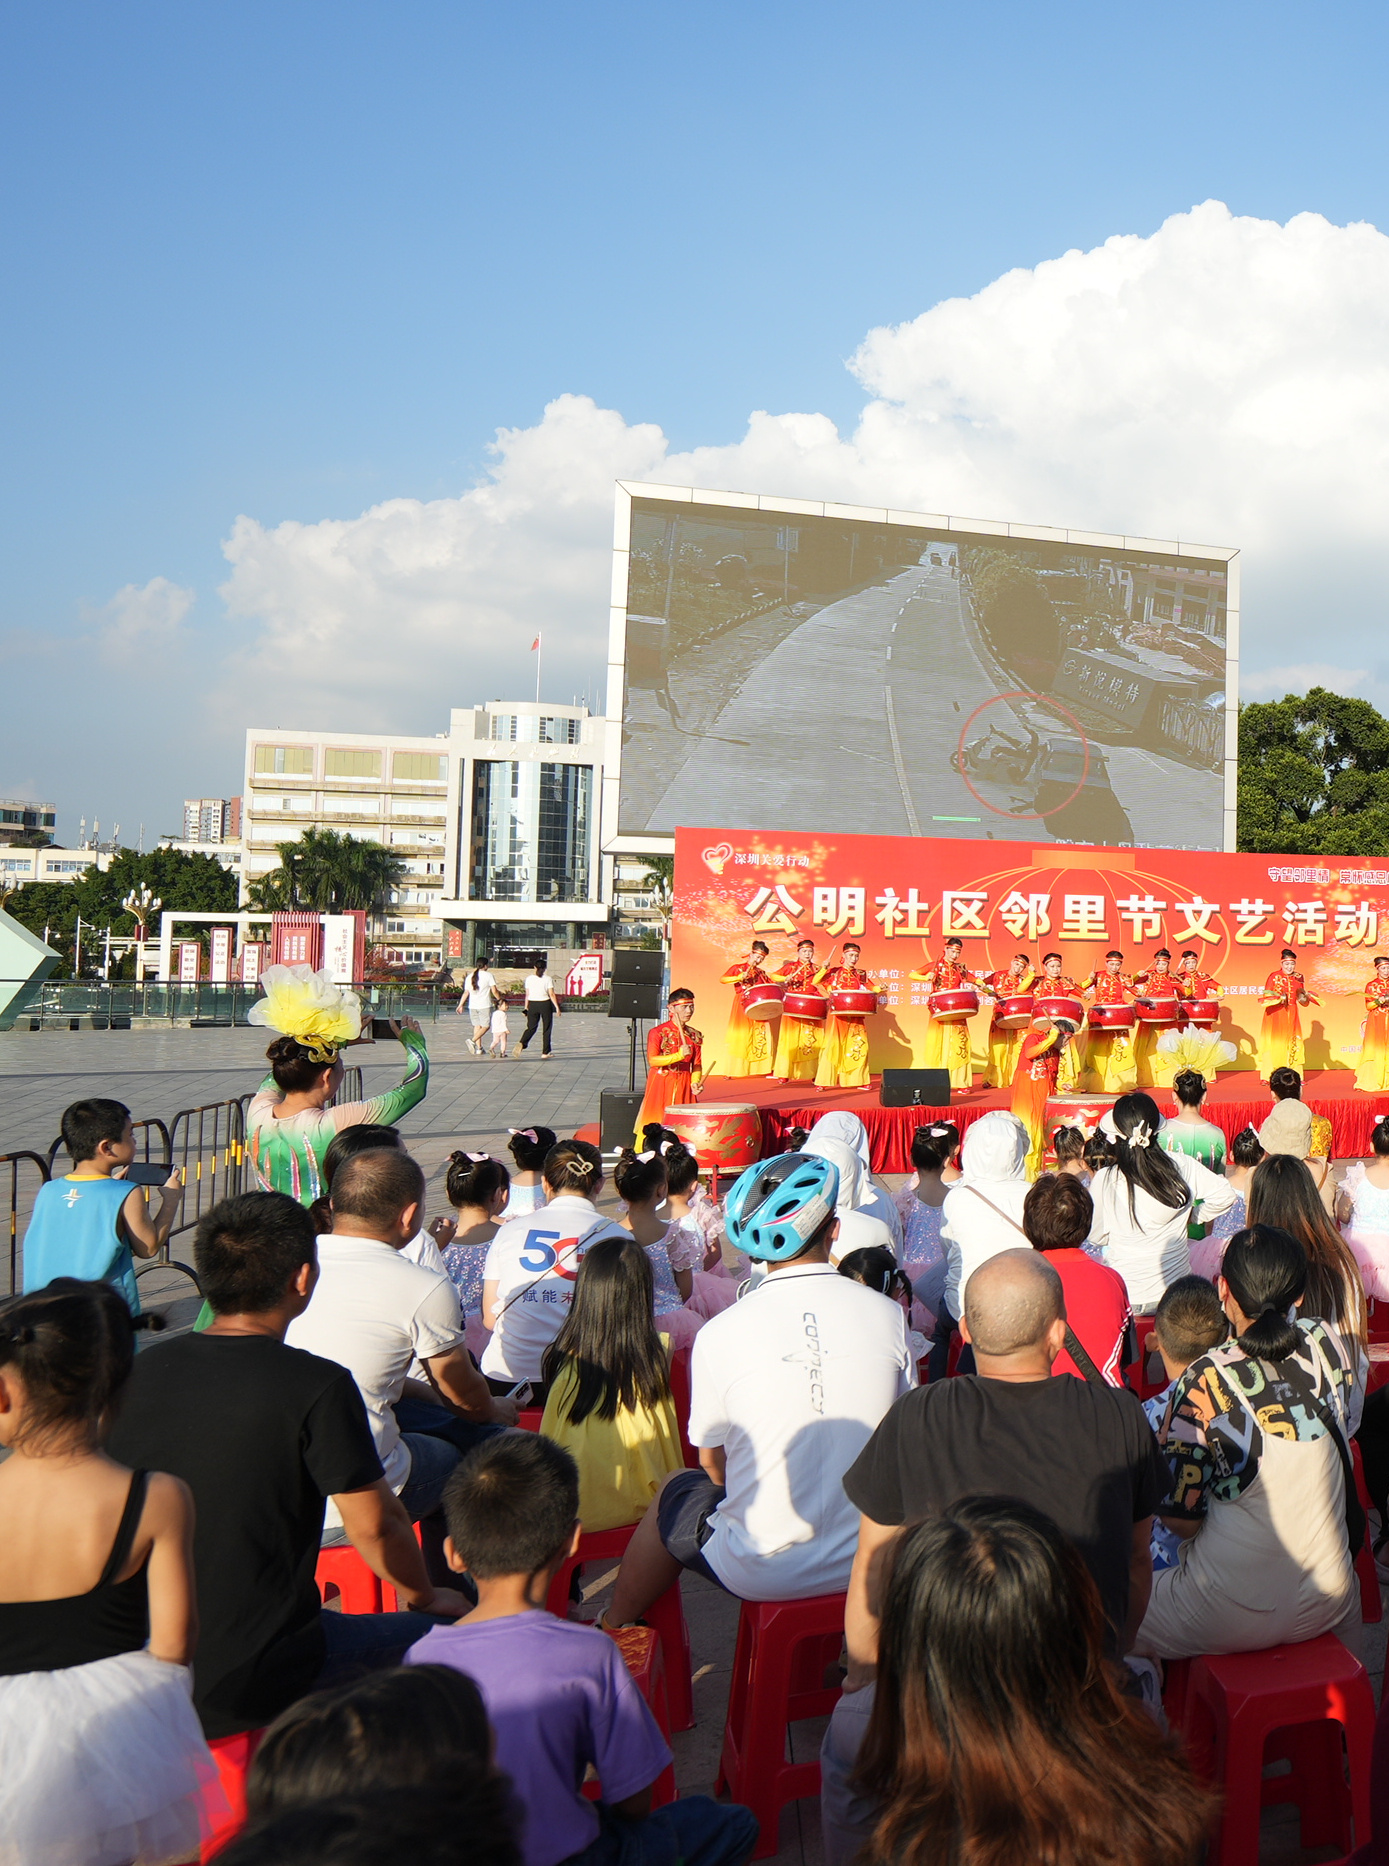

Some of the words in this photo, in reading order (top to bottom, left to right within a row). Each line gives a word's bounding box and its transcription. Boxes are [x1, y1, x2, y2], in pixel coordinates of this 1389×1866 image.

[734, 852, 810, 867] 深圳关爱行动
[1268, 867, 1330, 883] 守望邻里情
[743, 882, 1381, 948] 公明社区邻里节文艺活动
[522, 1288, 575, 1304] 赋能未
